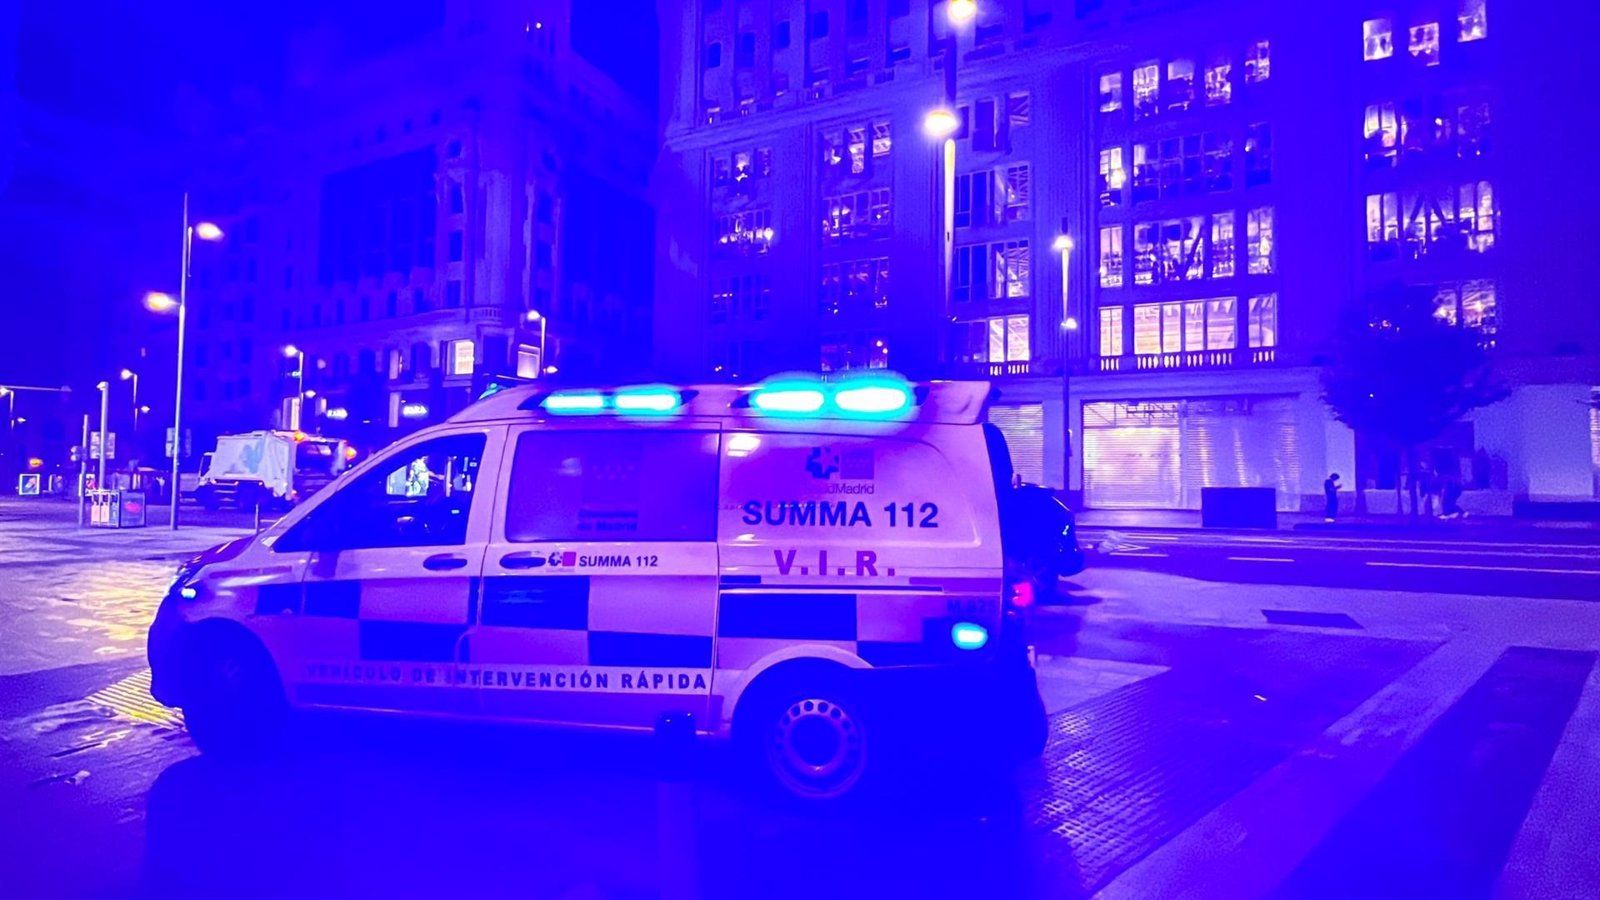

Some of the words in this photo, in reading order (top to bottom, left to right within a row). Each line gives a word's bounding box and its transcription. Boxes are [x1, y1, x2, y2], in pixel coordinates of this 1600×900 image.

[742, 500, 872, 527] SUMMA
[884, 501, 939, 529] 112
[578, 555, 632, 567] SUMMA
[636, 555, 659, 567] 112
[774, 549, 896, 577] V.I.R.
[412, 668, 435, 683] DE
[445, 668, 609, 689] INTERVENCIÓN
[621, 669, 707, 690] RÁPIDA
